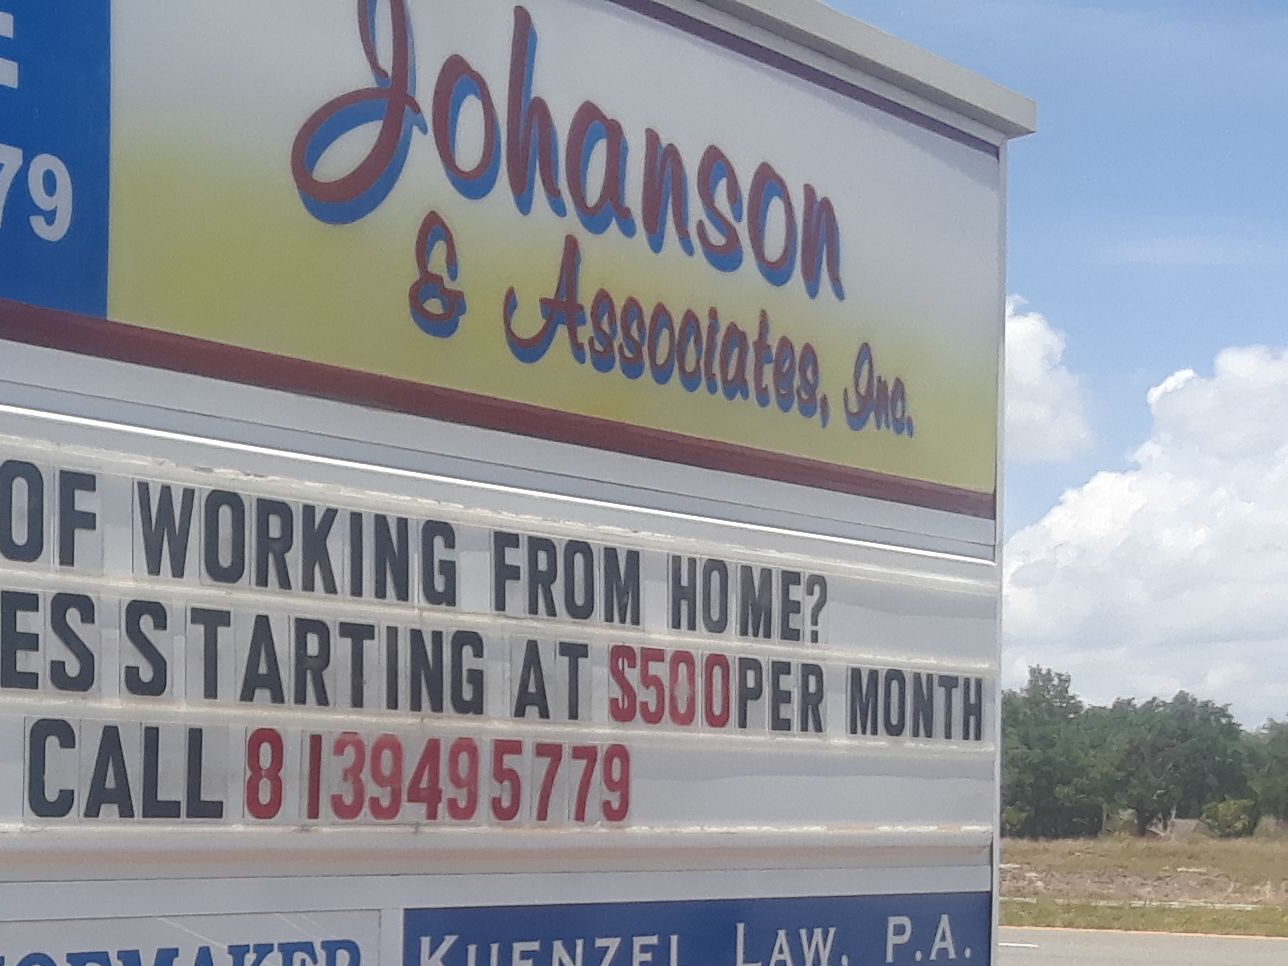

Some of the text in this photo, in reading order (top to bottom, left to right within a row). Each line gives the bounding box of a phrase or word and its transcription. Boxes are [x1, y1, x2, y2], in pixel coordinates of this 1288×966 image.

[291, 0, 846, 302] Johanson
[409, 210, 914, 438] & Associates, Inc.
[133, 480, 457, 608] WORKING
[492, 530, 643, 627] FROM
[670, 554, 828, 645] HOME?
[125, 600, 486, 716] STARTING
[513, 639, 590, 722] AT
[736, 656, 825, 734] PER
[848, 665, 984, 741] MONTH
[28, 717, 631, 822] CALL 8139495779
[883, 914, 974, 963] P.A.
